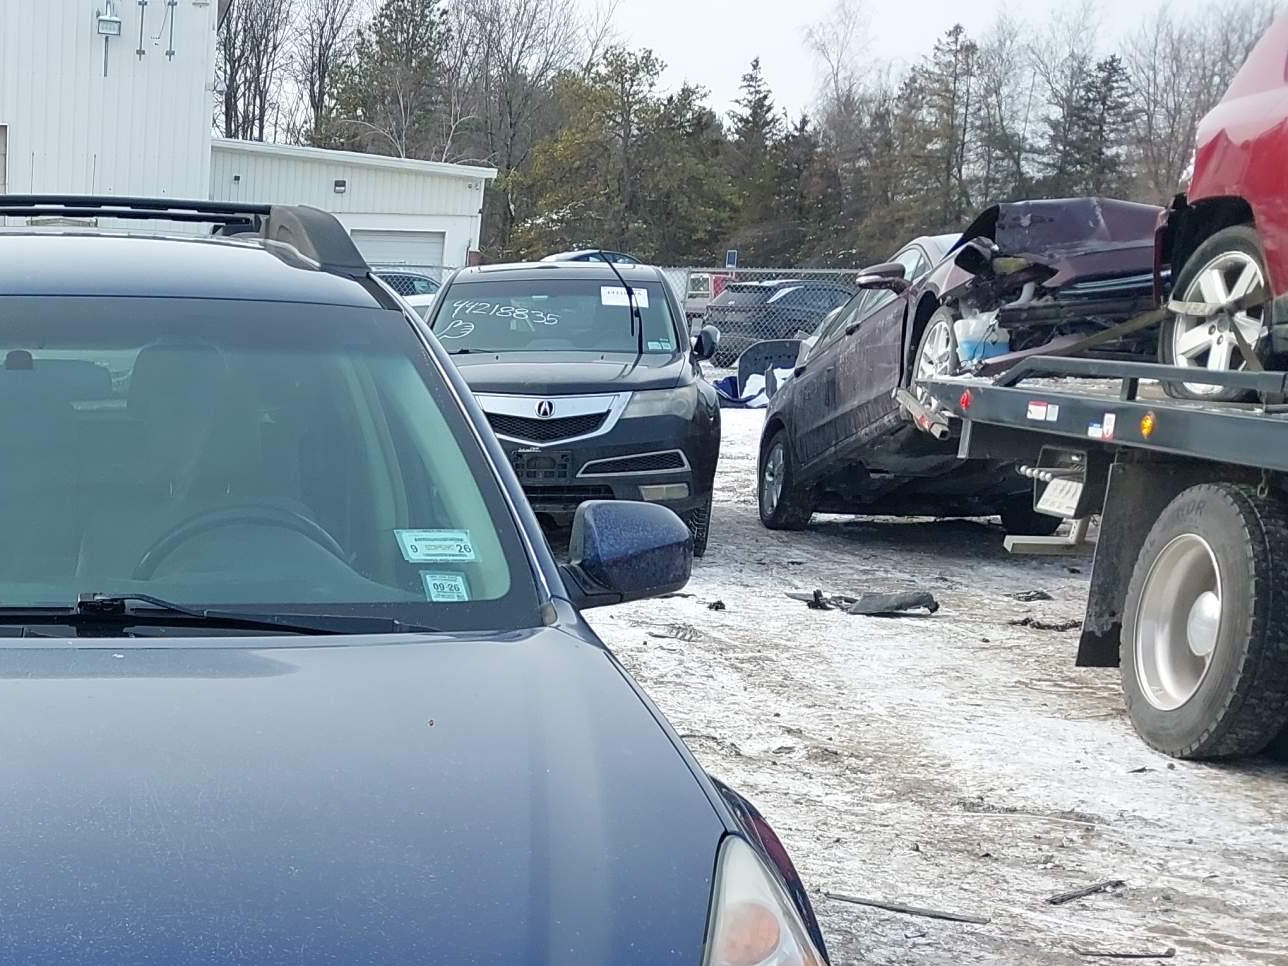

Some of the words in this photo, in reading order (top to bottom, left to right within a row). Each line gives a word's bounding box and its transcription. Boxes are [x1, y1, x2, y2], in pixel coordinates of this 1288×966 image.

[452, 299, 560, 325] 44218835
[410, 544, 418, 553] 9
[455, 544, 472, 553] 26
